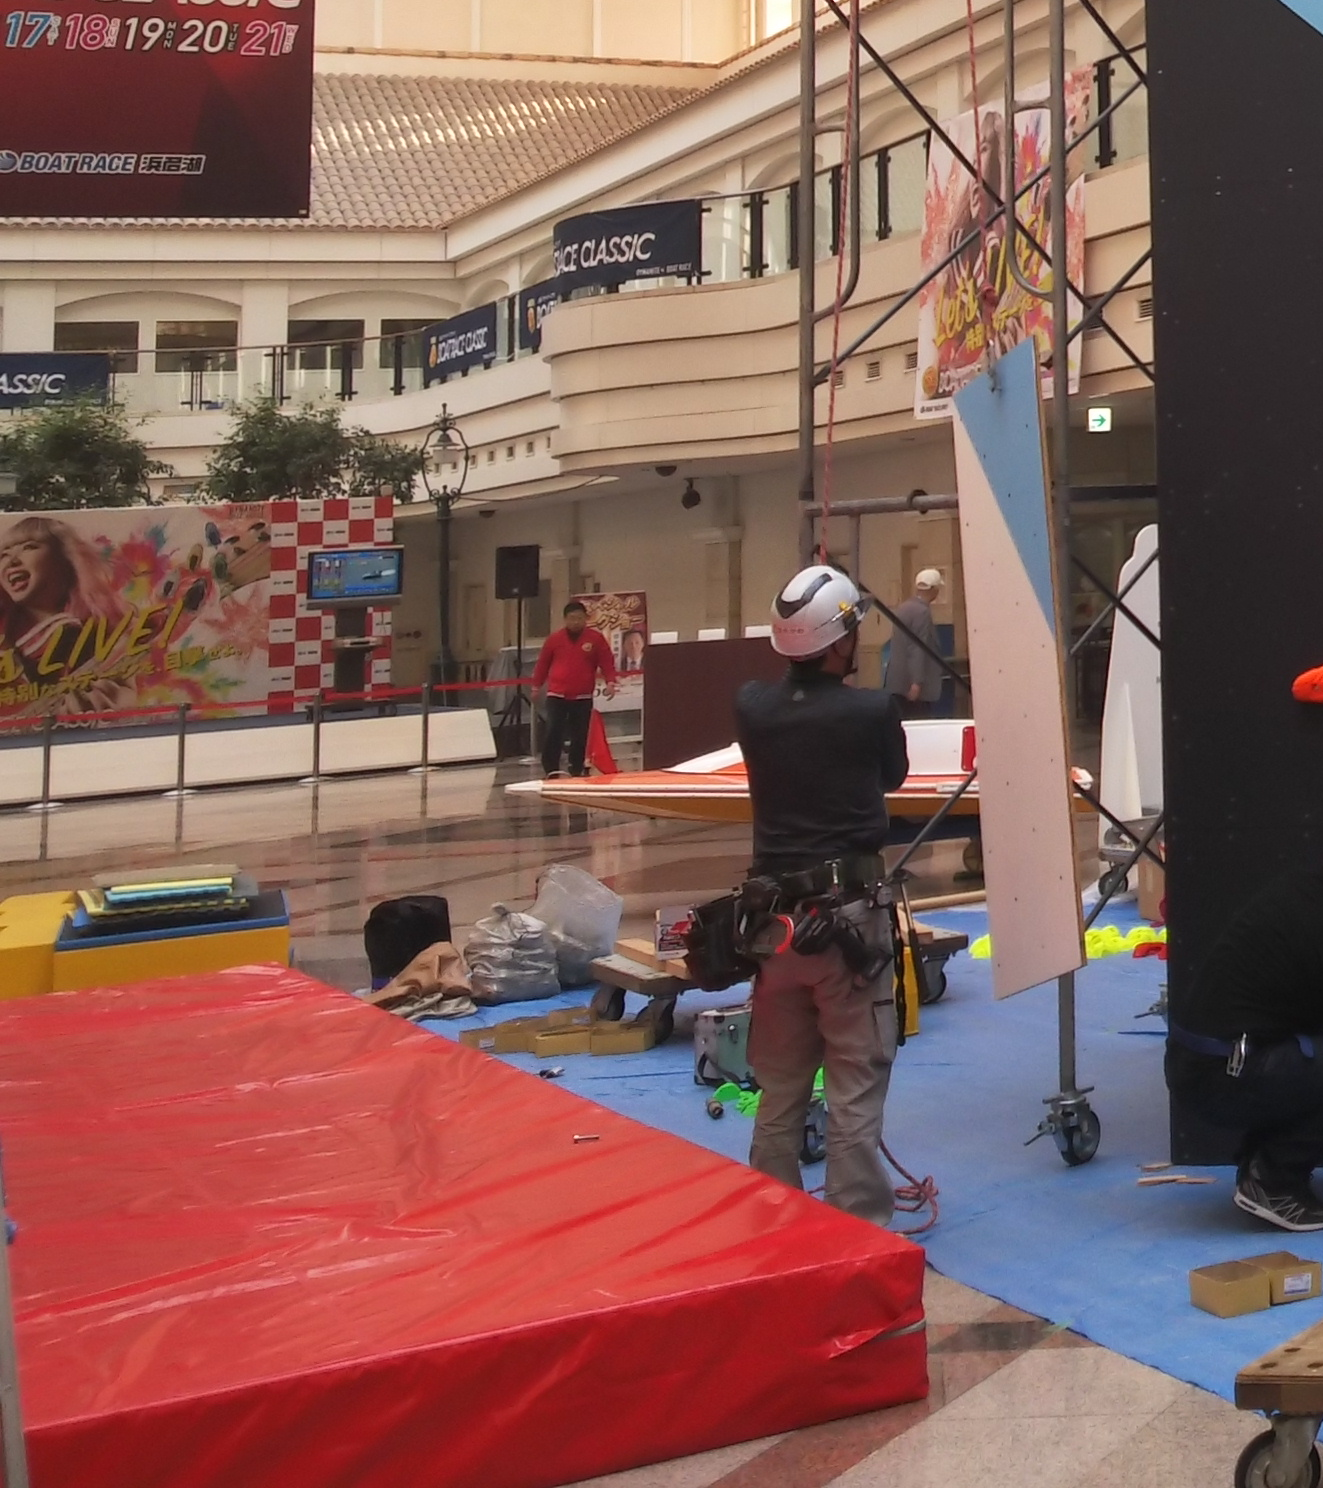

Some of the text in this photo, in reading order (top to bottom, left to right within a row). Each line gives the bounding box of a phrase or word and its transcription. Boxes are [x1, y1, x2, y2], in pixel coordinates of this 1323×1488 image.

[5, 11, 53, 48] 17
[65, 13, 110, 50] 18
[125, 17, 165, 51] 19
[178, 19, 230, 53] 20
[240, 20, 288, 56] 21
[19, 152, 78, 173] BOAT
[78, 153, 137, 174] RACE
[580, 232, 656, 269] CLASSIC
[37, 596, 184, 676] LIVE!
